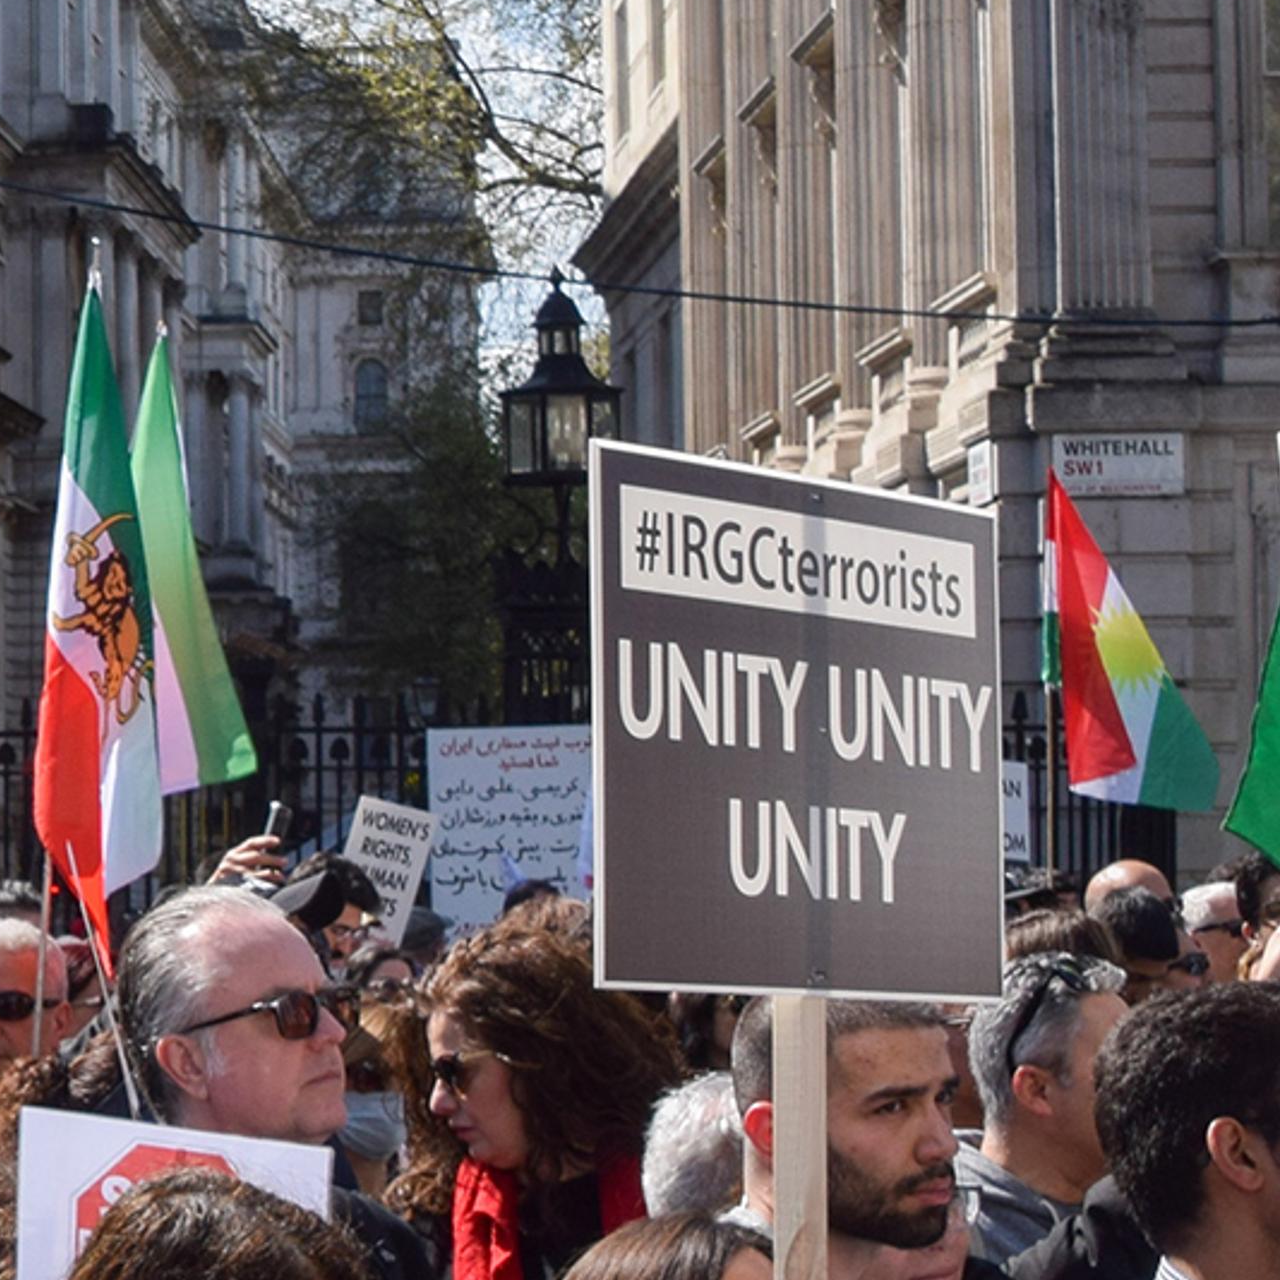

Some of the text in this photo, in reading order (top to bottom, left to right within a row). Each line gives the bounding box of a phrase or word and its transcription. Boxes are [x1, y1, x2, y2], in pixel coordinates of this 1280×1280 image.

[1062, 439, 1174, 457] WHITEHALL
[635, 510, 962, 618] #IRGCterrorists
[619, 638, 993, 773] UNITY UNITY
[362, 808, 431, 842] WOMEN'S
[729, 797, 907, 903] UNITY
